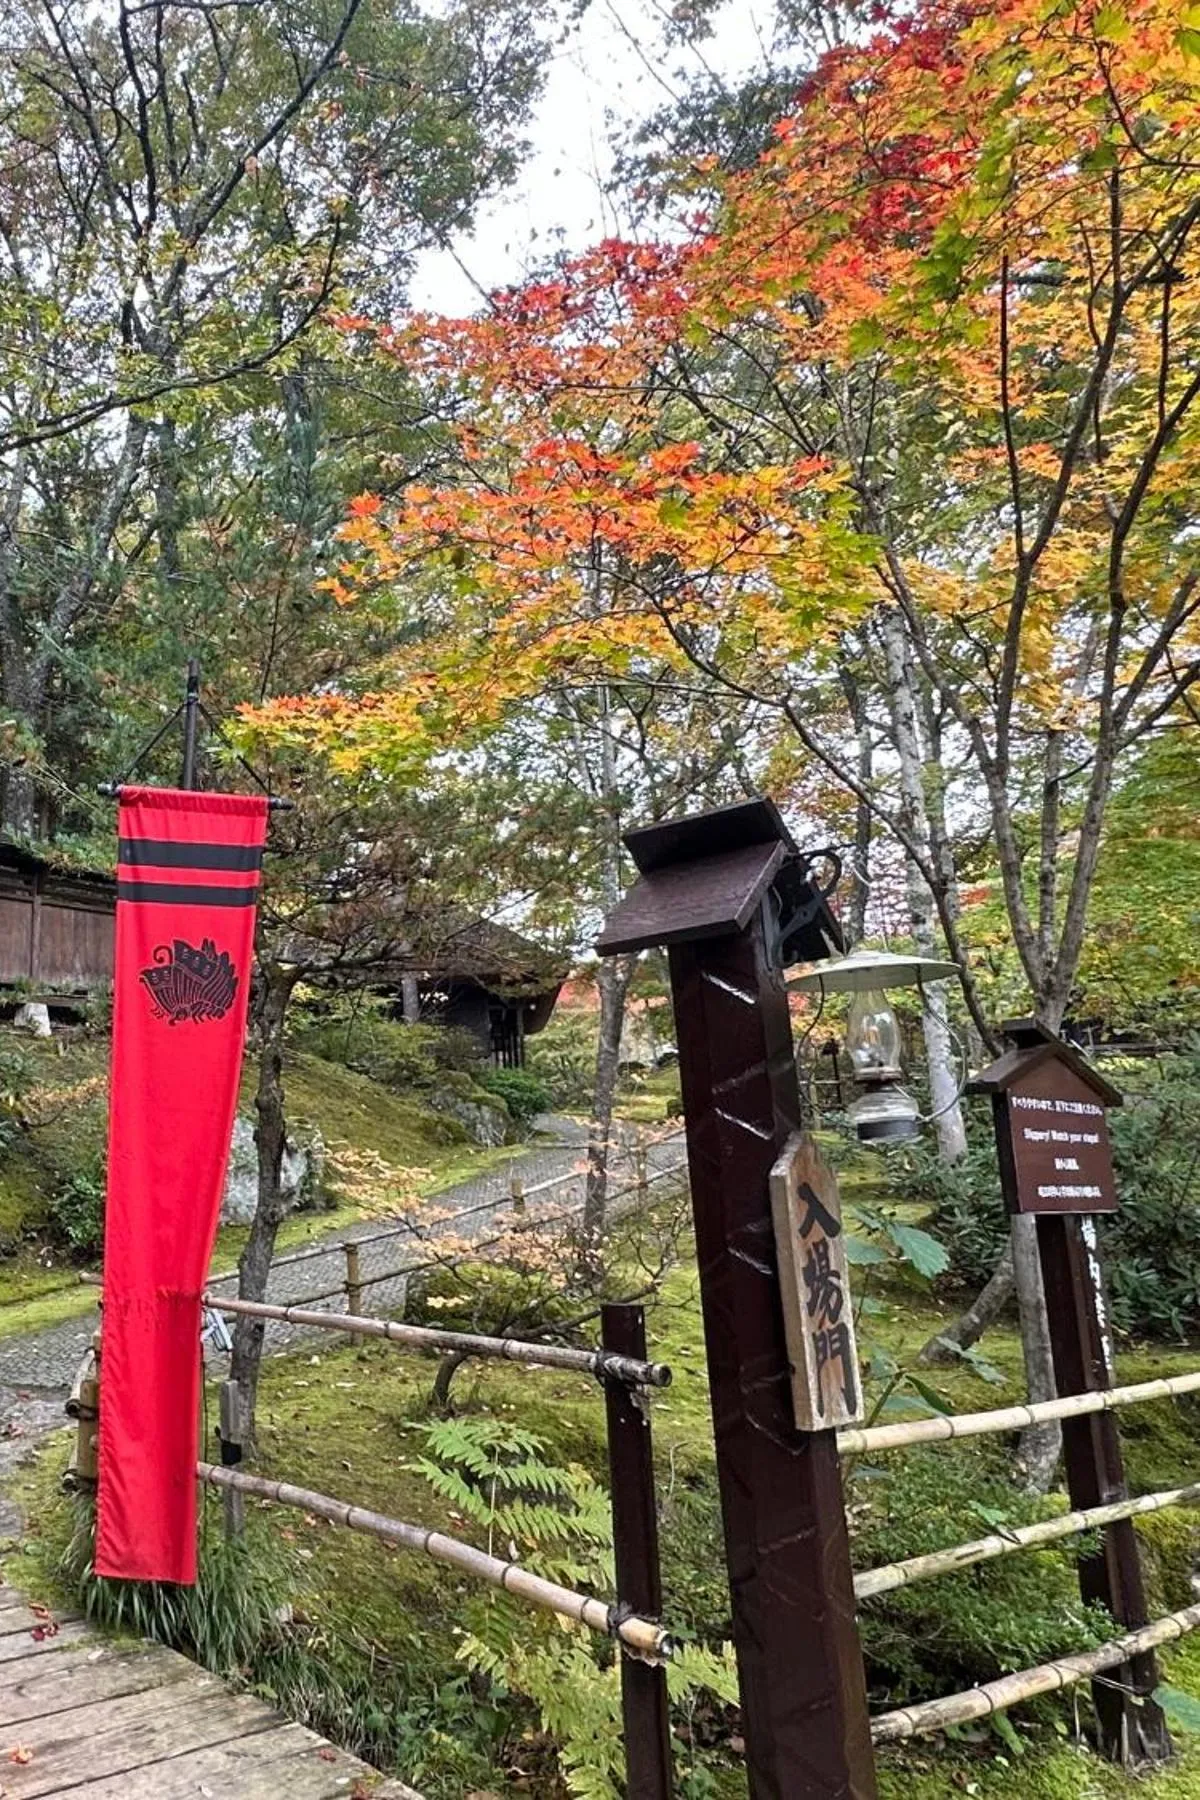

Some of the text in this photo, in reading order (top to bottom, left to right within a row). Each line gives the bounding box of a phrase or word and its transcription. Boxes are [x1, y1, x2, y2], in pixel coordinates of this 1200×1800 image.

[1051, 1130, 1069, 1142] Watch
[1069, 1133, 1082, 1144] your
[797, 1181, 857, 1418] 入場門
